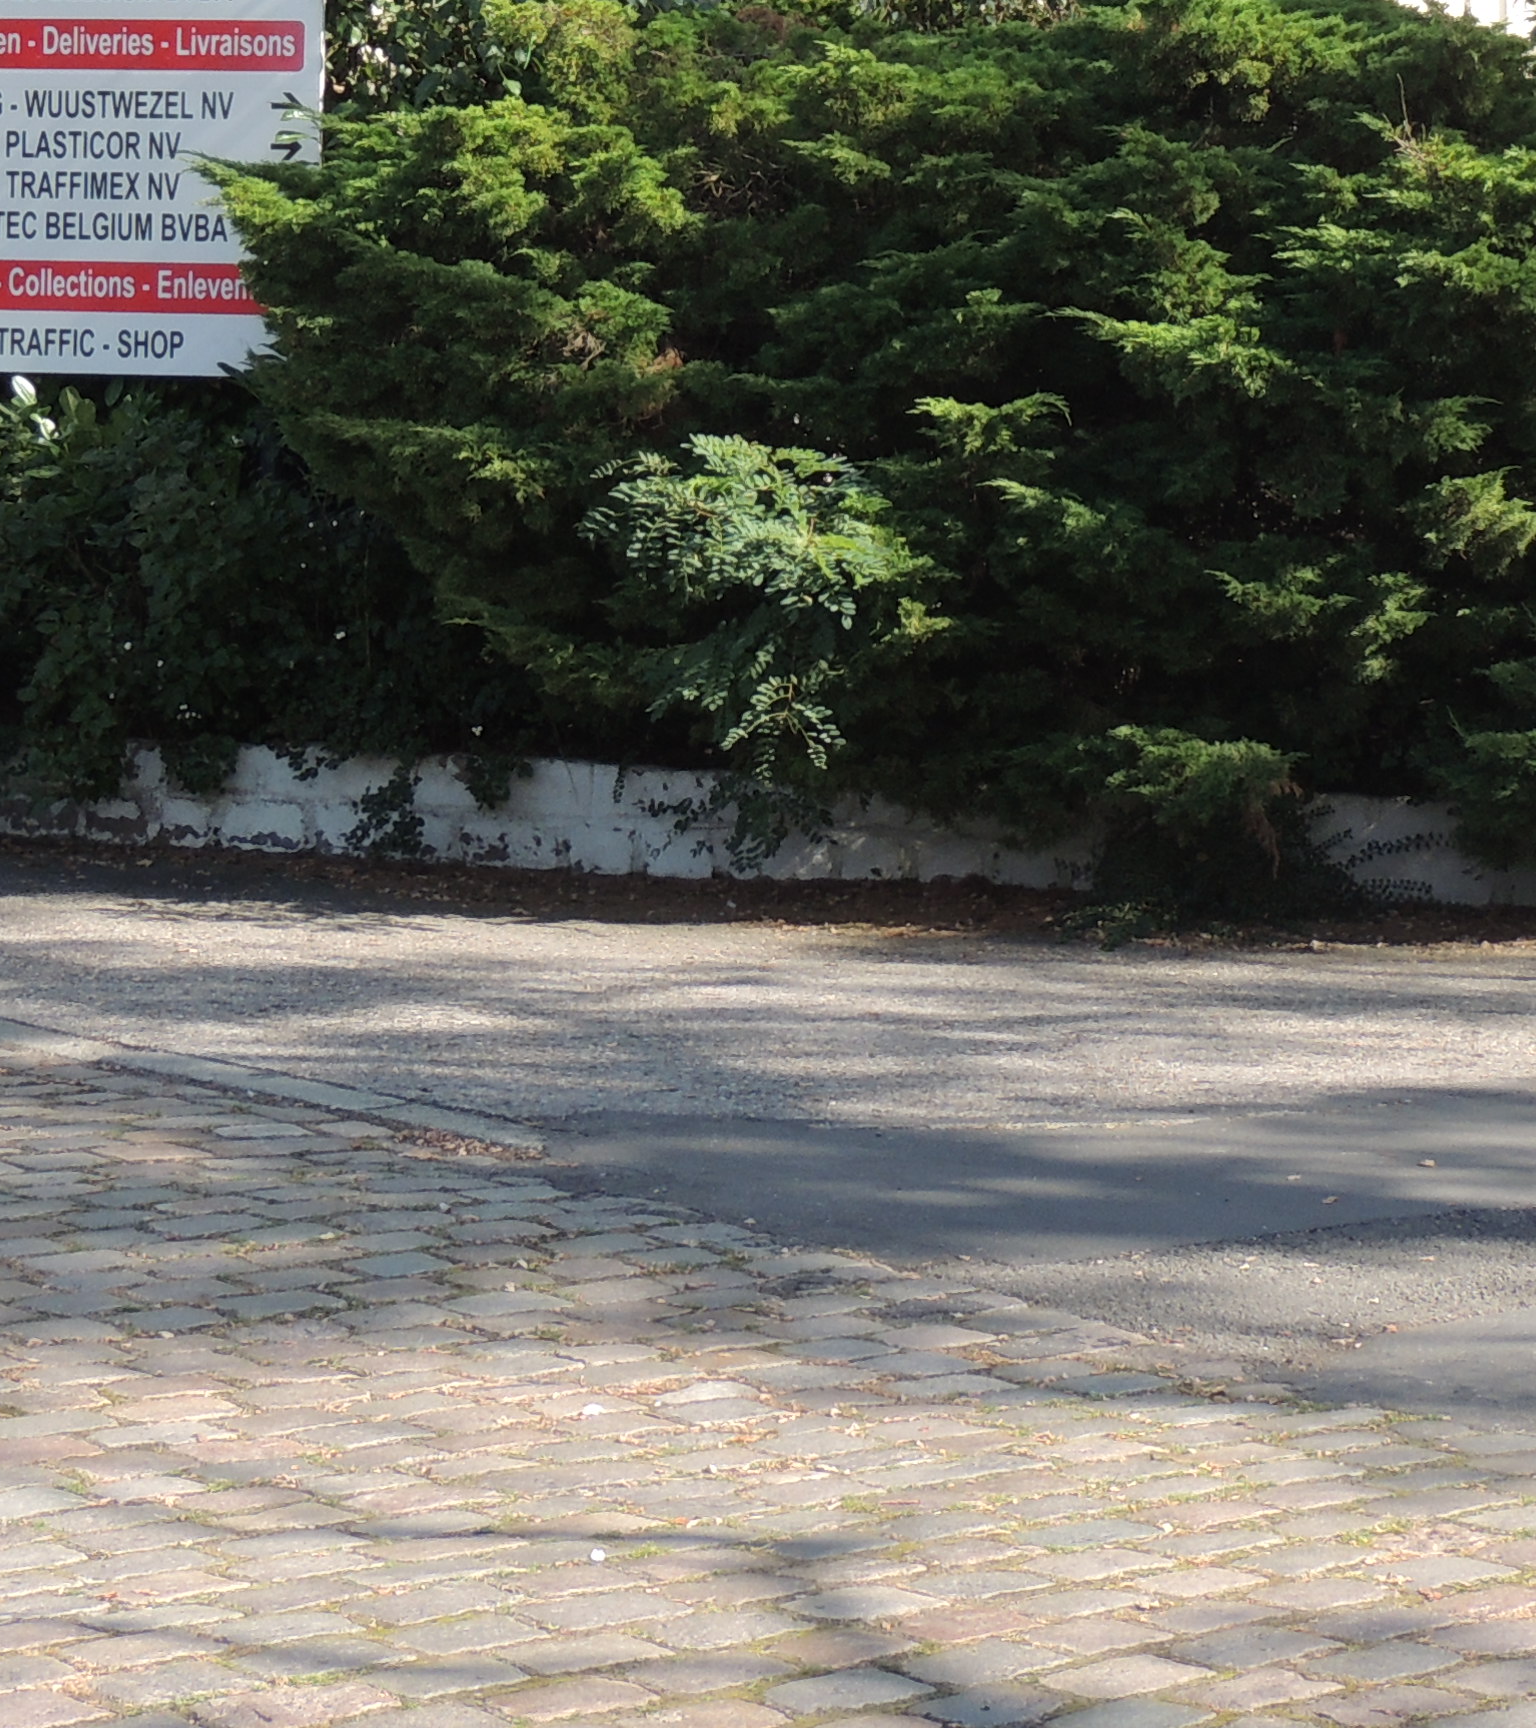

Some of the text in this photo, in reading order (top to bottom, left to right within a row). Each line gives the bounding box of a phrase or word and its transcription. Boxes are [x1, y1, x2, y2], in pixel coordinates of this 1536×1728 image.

[42, 25, 154, 56] Deliveries
[176, 27, 296, 57] Livraisons
[24, 89, 194, 119] WUUSTWEZEL
[201, 91, 234, 120] NV
[5, 130, 180, 160] PLASTICOR NV
[5, 170, 181, 201] TRAFFIMEX NV
[45, 211, 153, 241] BELGIUM
[161, 213, 228, 242] BVBA
[8, 266, 135, 298] Collections
[117, 329, 184, 359] SHOP
